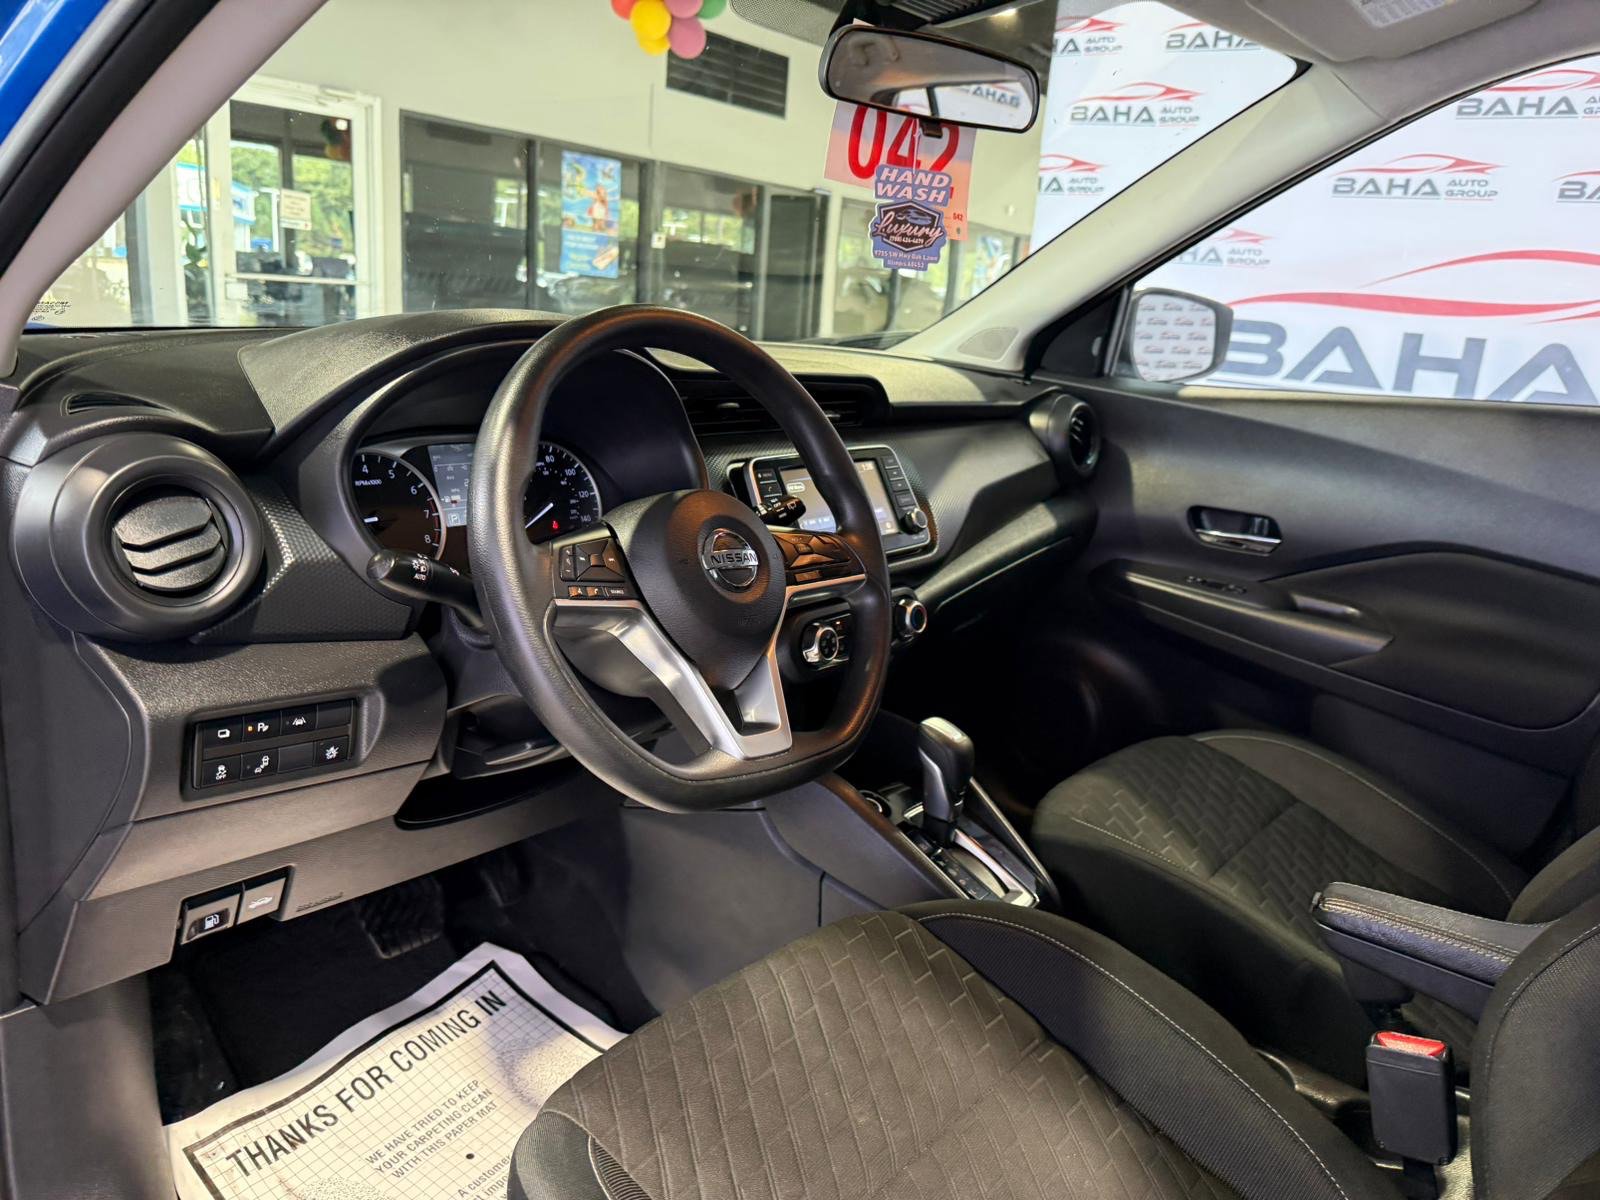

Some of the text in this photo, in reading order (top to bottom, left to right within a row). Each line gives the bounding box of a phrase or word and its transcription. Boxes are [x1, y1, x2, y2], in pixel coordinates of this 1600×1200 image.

[1085, 36, 1116, 44] AUTO
[1083, 45, 1122, 53] GROUP
[1161, 107, 1193, 115] AUTO
[1456, 96, 1579, 116] BAHA
[1071, 105, 1155, 124] BAHA
[1159, 115, 1201, 124] GROUP
[880, 168, 949, 188] HAND
[1069, 177, 1098, 185] AUTO
[1447, 179, 1489, 187] AUTO
[1332, 178, 1440, 196] BAHA
[877, 182, 946, 203] WASH
[1445, 190, 1498, 198] GROUP
[874, 211, 944, 248] Luxury
[1228, 248, 1262, 256] AUTO
[1227, 257, 1271, 266] GROUP
[1219, 319, 1599, 406] BAHA
[545, 455, 555, 463] 80
[361, 464, 369, 474] 4
[388, 469, 396, 479] 5
[565, 468, 576, 476] 100
[410, 485, 418, 495] 6
[578, 490, 589, 498] 120
[424, 509, 430, 519] 7
[424, 534, 431, 544] 8
[711, 552, 758, 565] NISSAN
[226, 990, 507, 1177] THANKS FOR COMING IN
[365, 1079, 480, 1165] WE HAVE TRIED TO KEEP
[375, 1088, 493, 1174] YOUR CARPETING CLEAN
[391, 1100, 498, 1179] WITH THIS PAPER MAT
[458, 1189, 469, 1198] A
